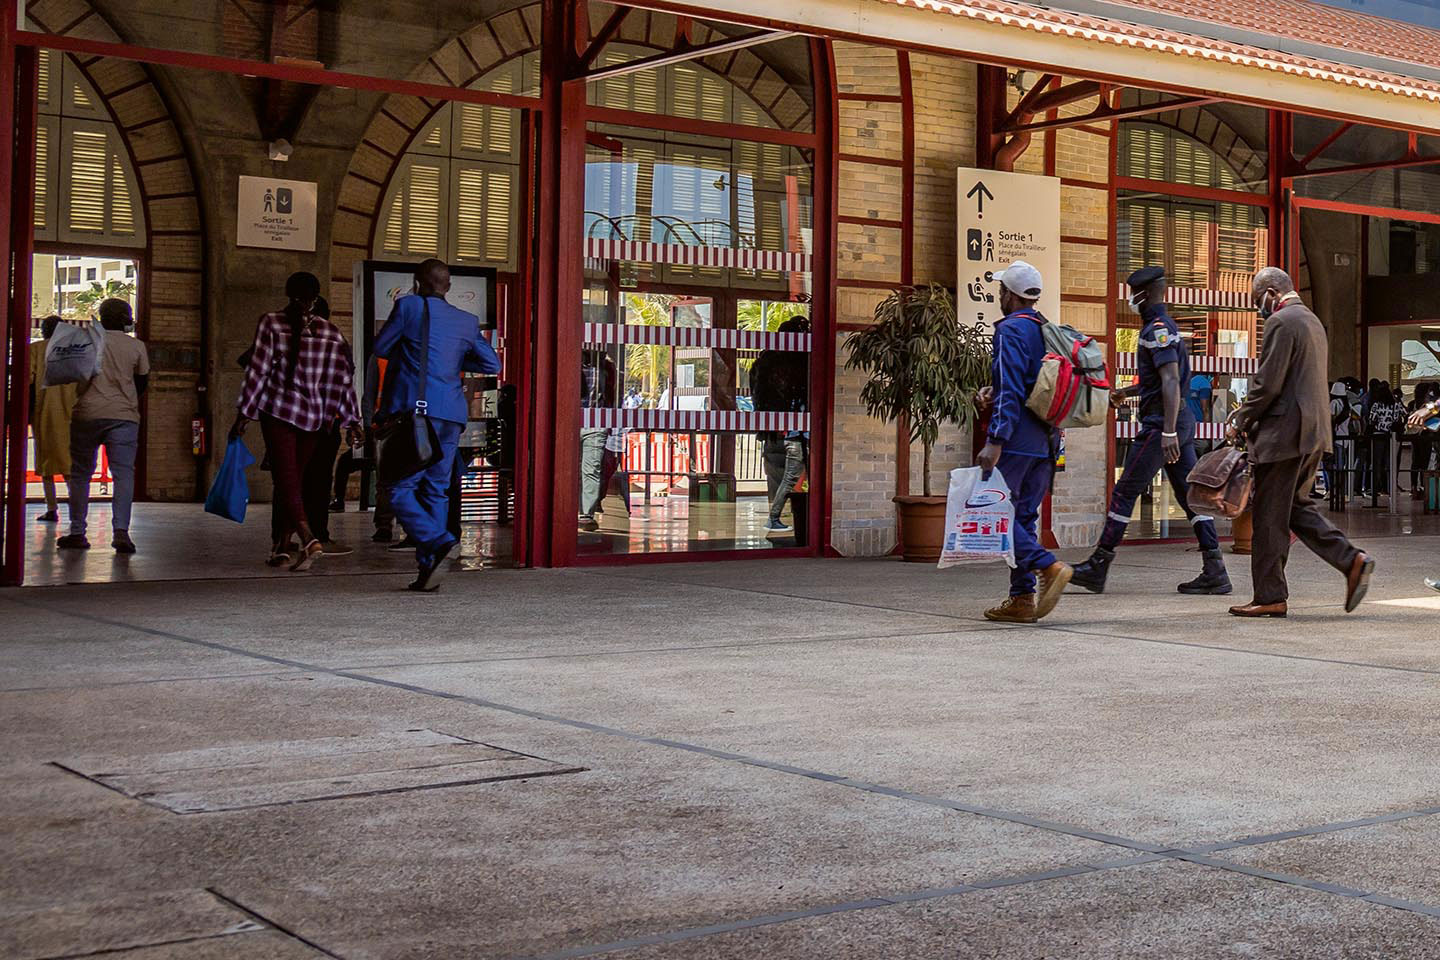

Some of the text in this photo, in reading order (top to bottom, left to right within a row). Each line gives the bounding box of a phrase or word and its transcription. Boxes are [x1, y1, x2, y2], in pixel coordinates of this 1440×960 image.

[262, 216, 287, 224] Sortie
[998, 230, 1033, 242] Sortie 1
[1022, 243, 1047, 251] Tirailleur
